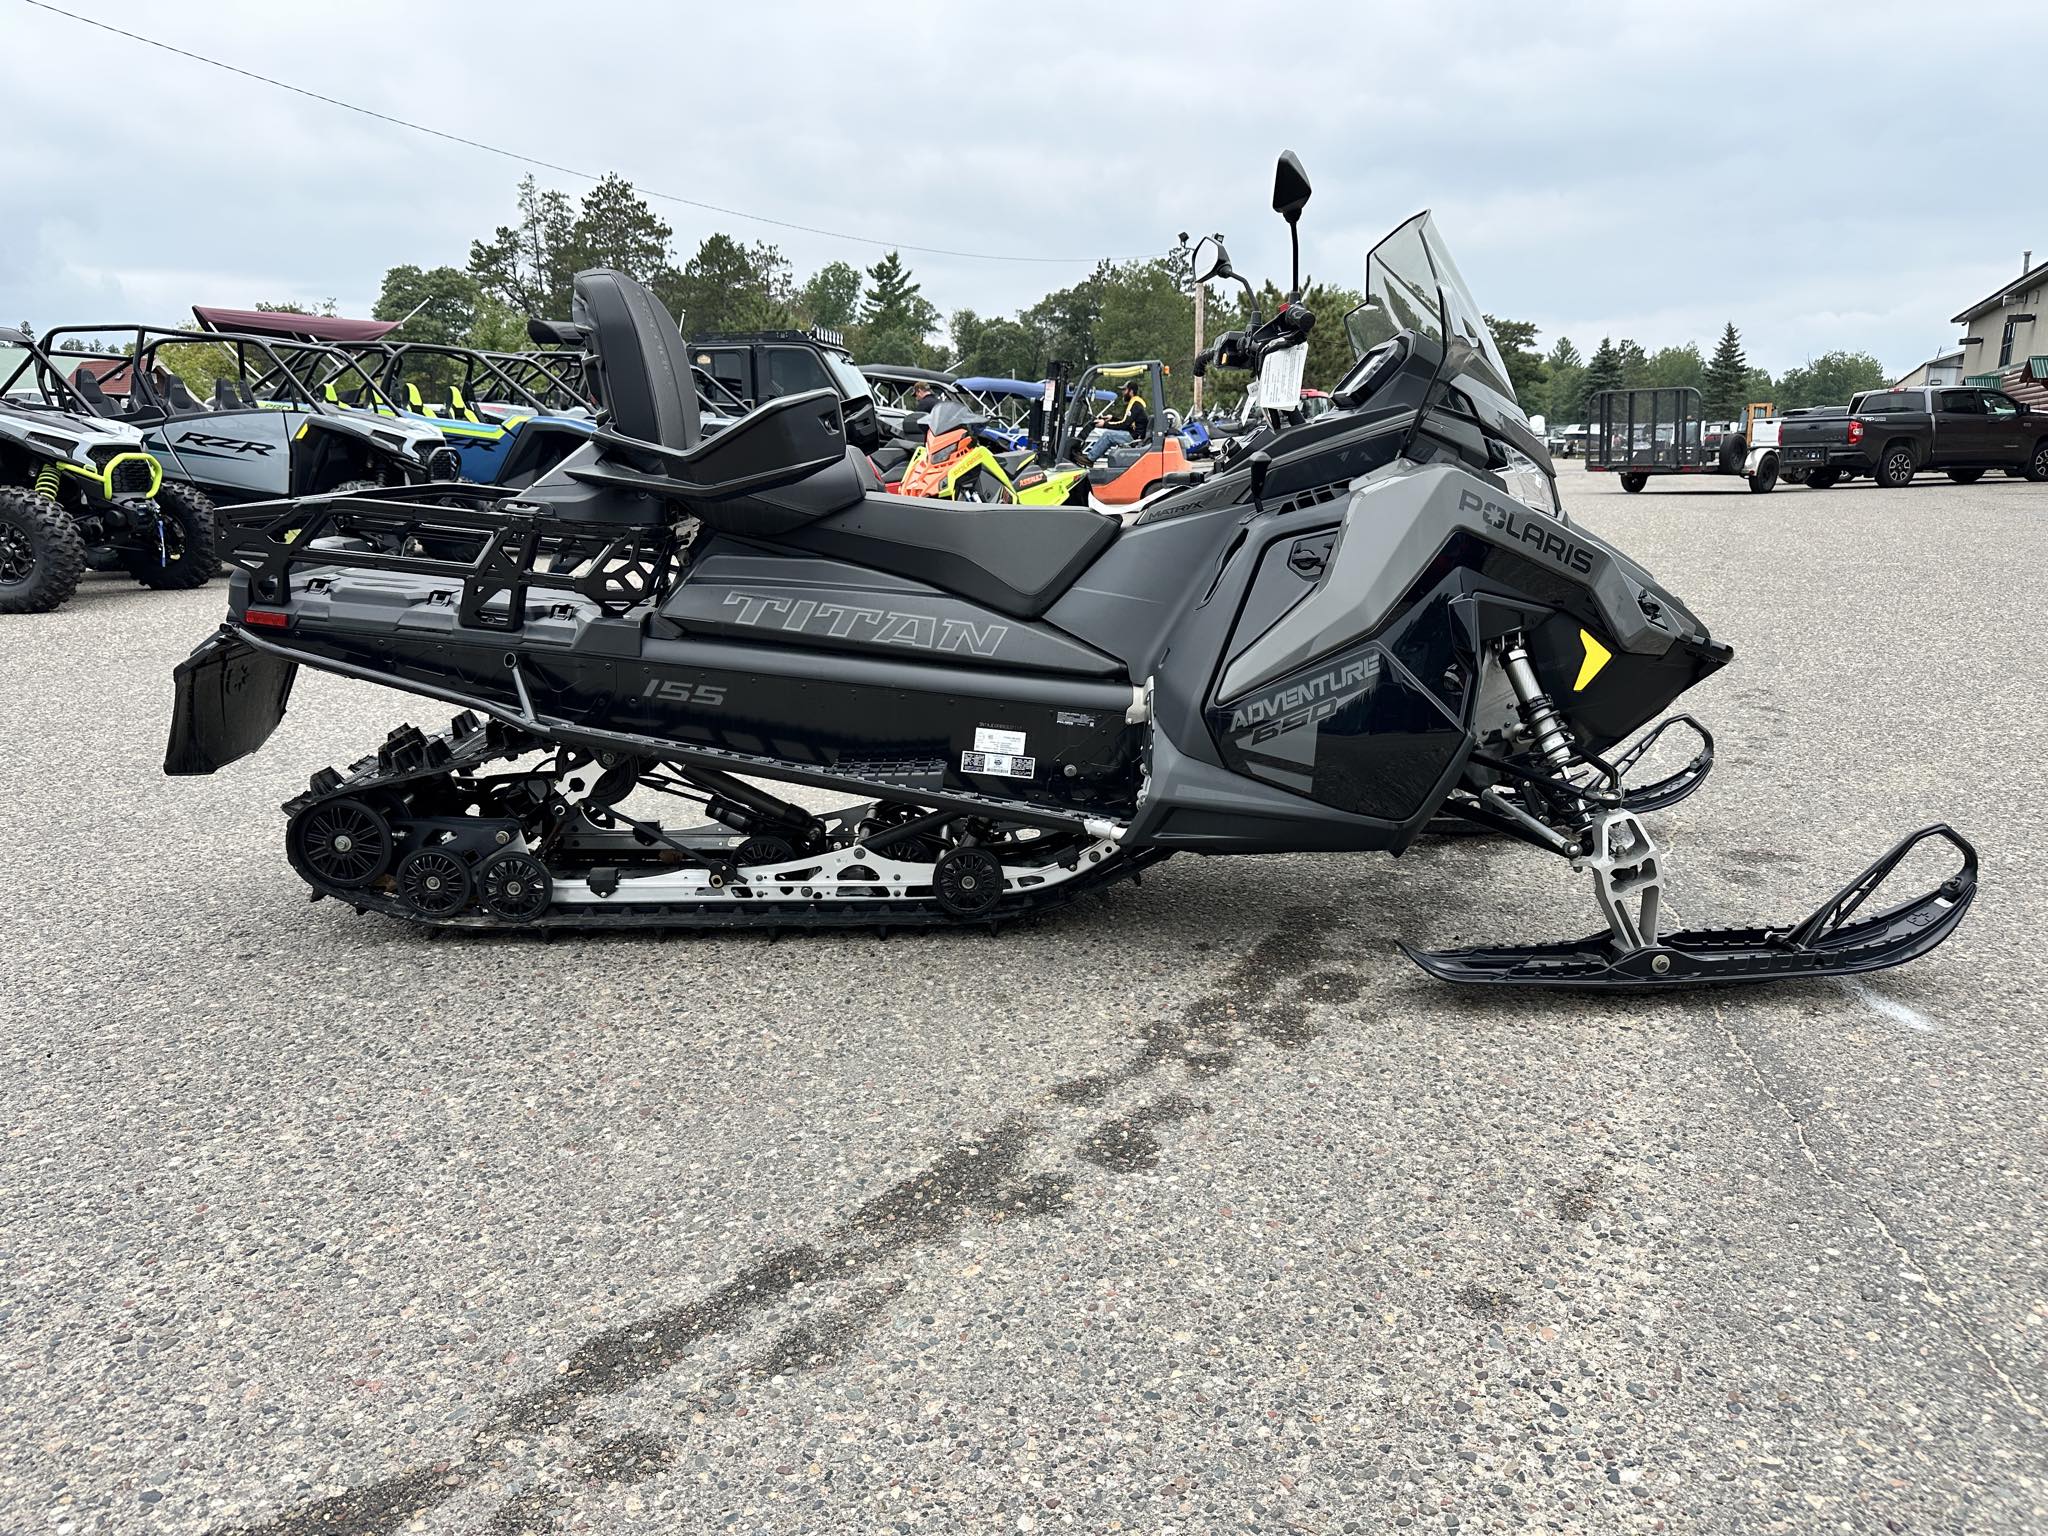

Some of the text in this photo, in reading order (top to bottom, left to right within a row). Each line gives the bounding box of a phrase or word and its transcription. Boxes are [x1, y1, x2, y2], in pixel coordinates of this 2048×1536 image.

[176, 431, 277, 457] RZR
[1149, 501, 1205, 521] MATRYX
[1459, 489, 1594, 574] POLARIS
[723, 591, 1008, 656] TITAN
[642, 679, 728, 706] 155
[1229, 653, 1381, 733] ADVENTURE
[1251, 696, 1339, 746] 650
